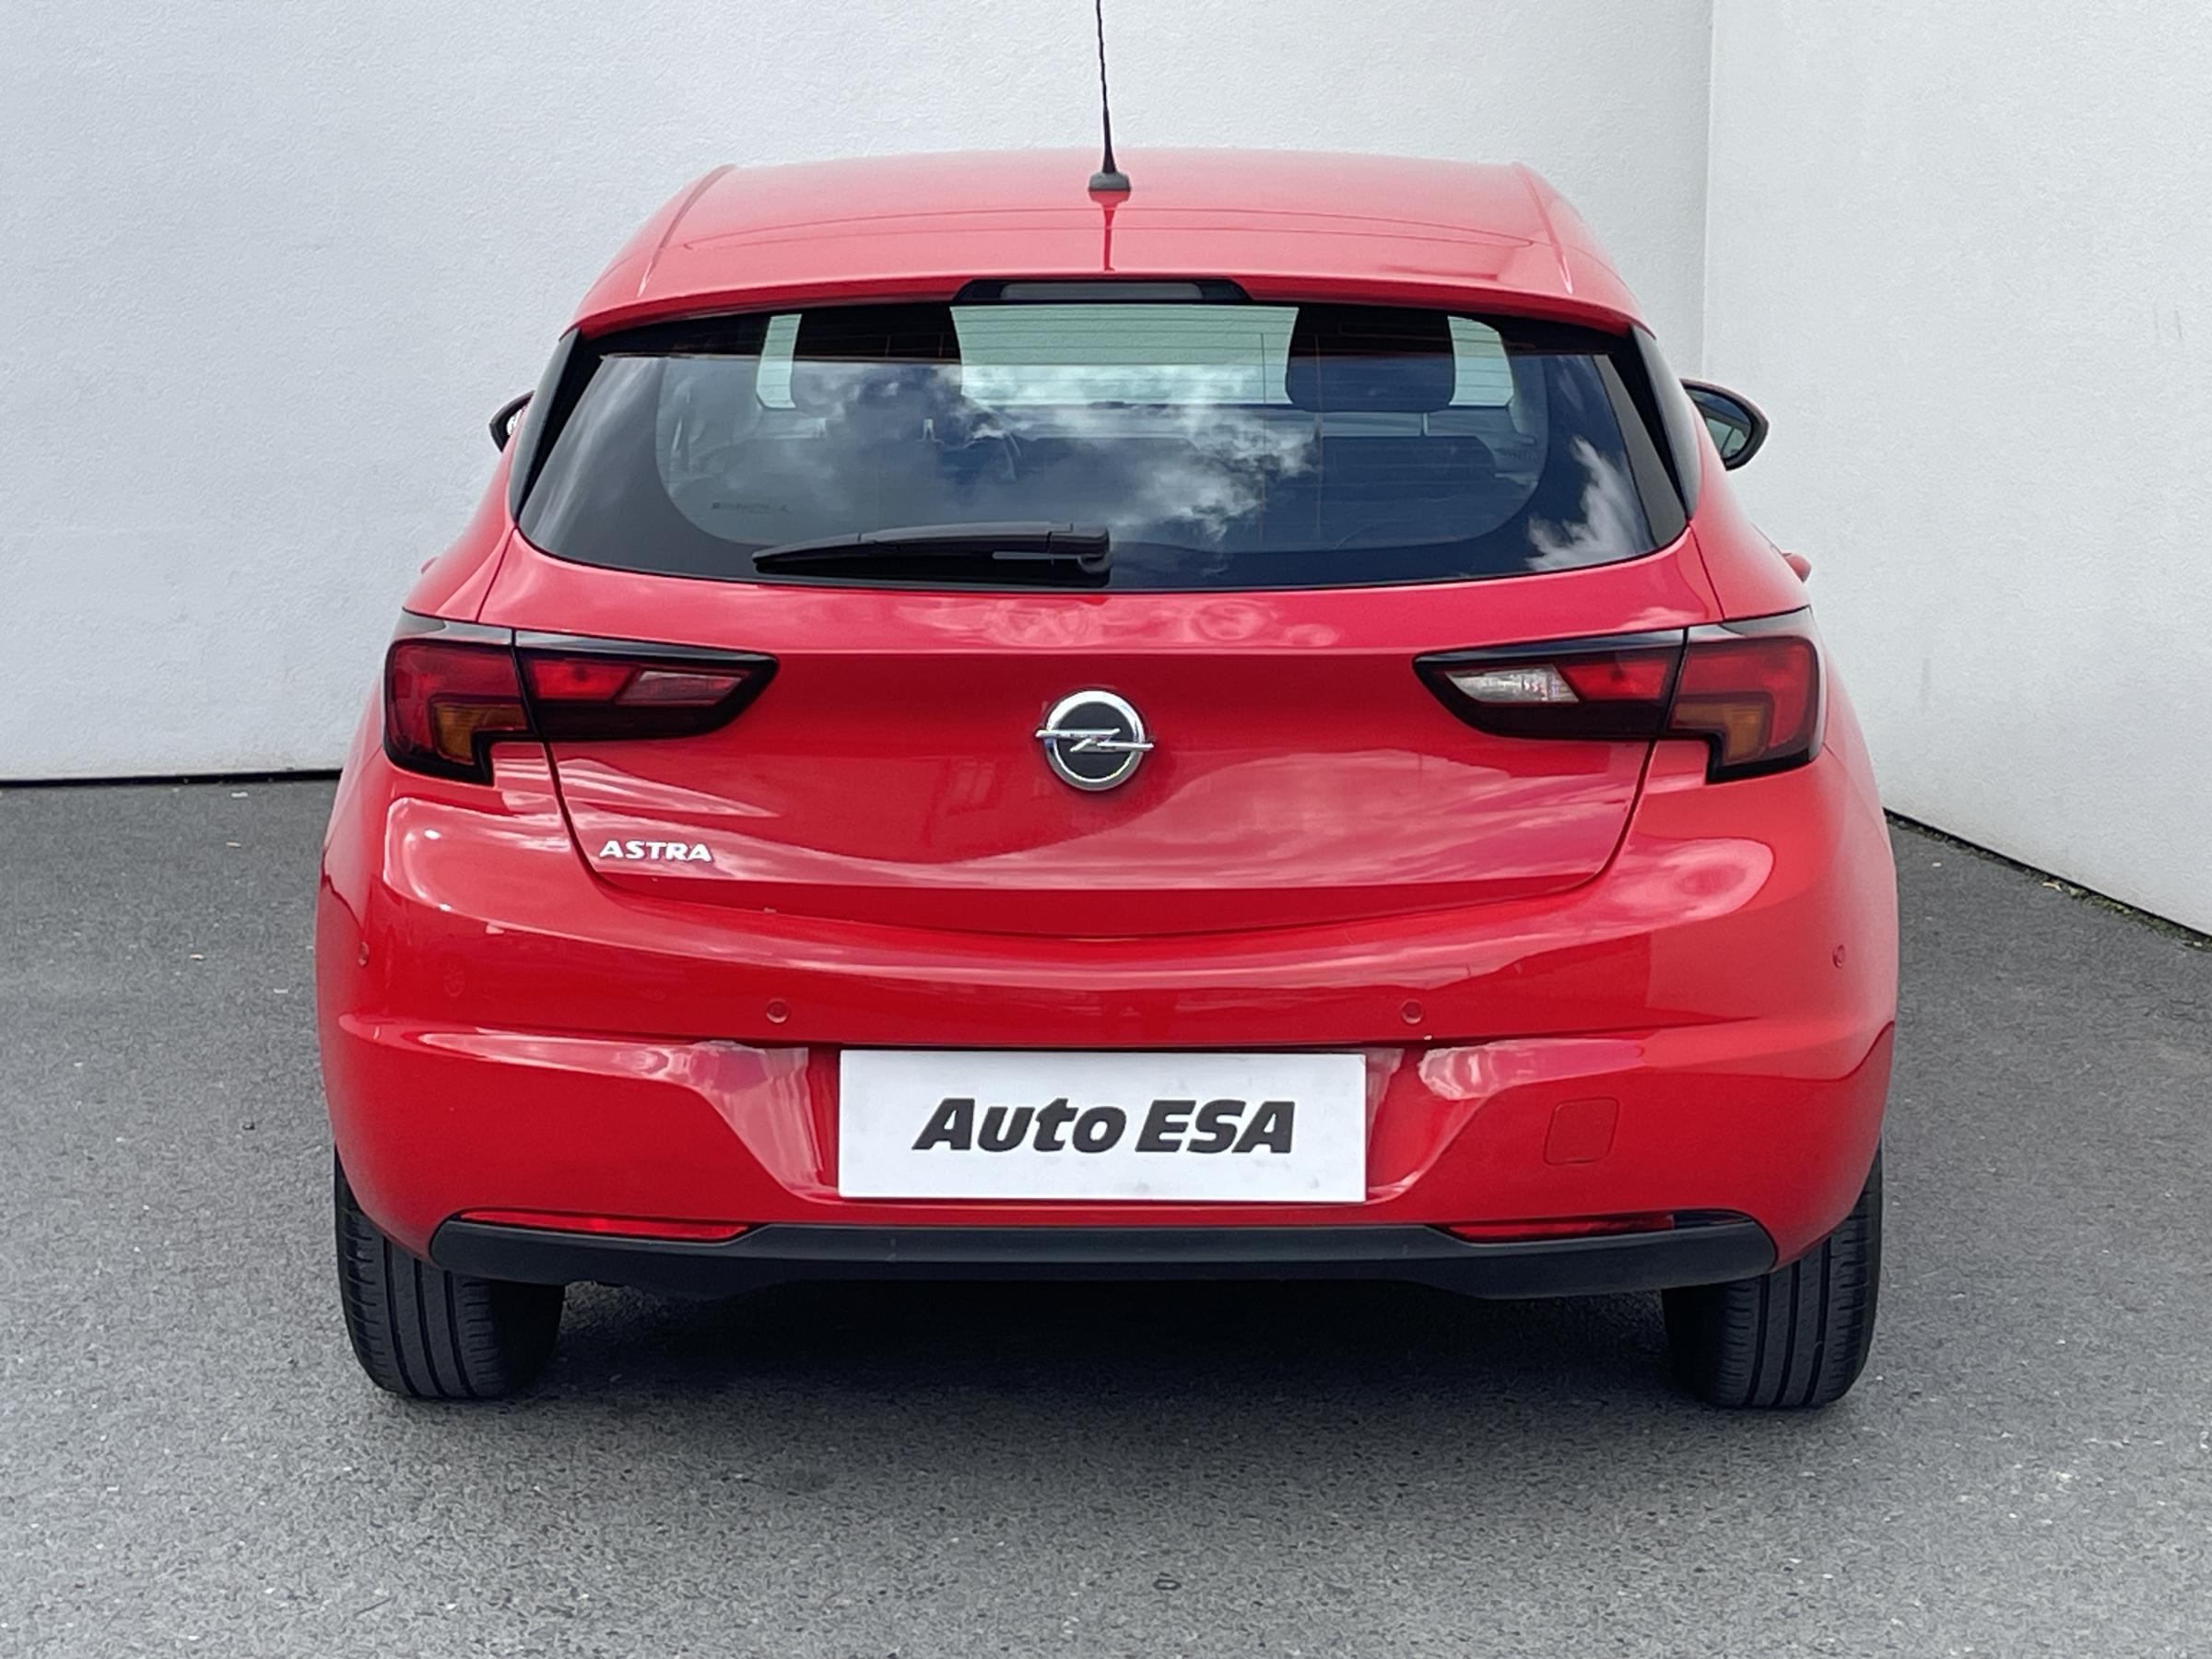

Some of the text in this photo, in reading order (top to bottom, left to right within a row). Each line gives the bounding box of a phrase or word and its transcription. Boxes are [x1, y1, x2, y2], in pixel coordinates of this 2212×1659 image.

[599, 840, 712, 863] ASTRA
[912, 1099, 1294, 1153] Auto ESA
